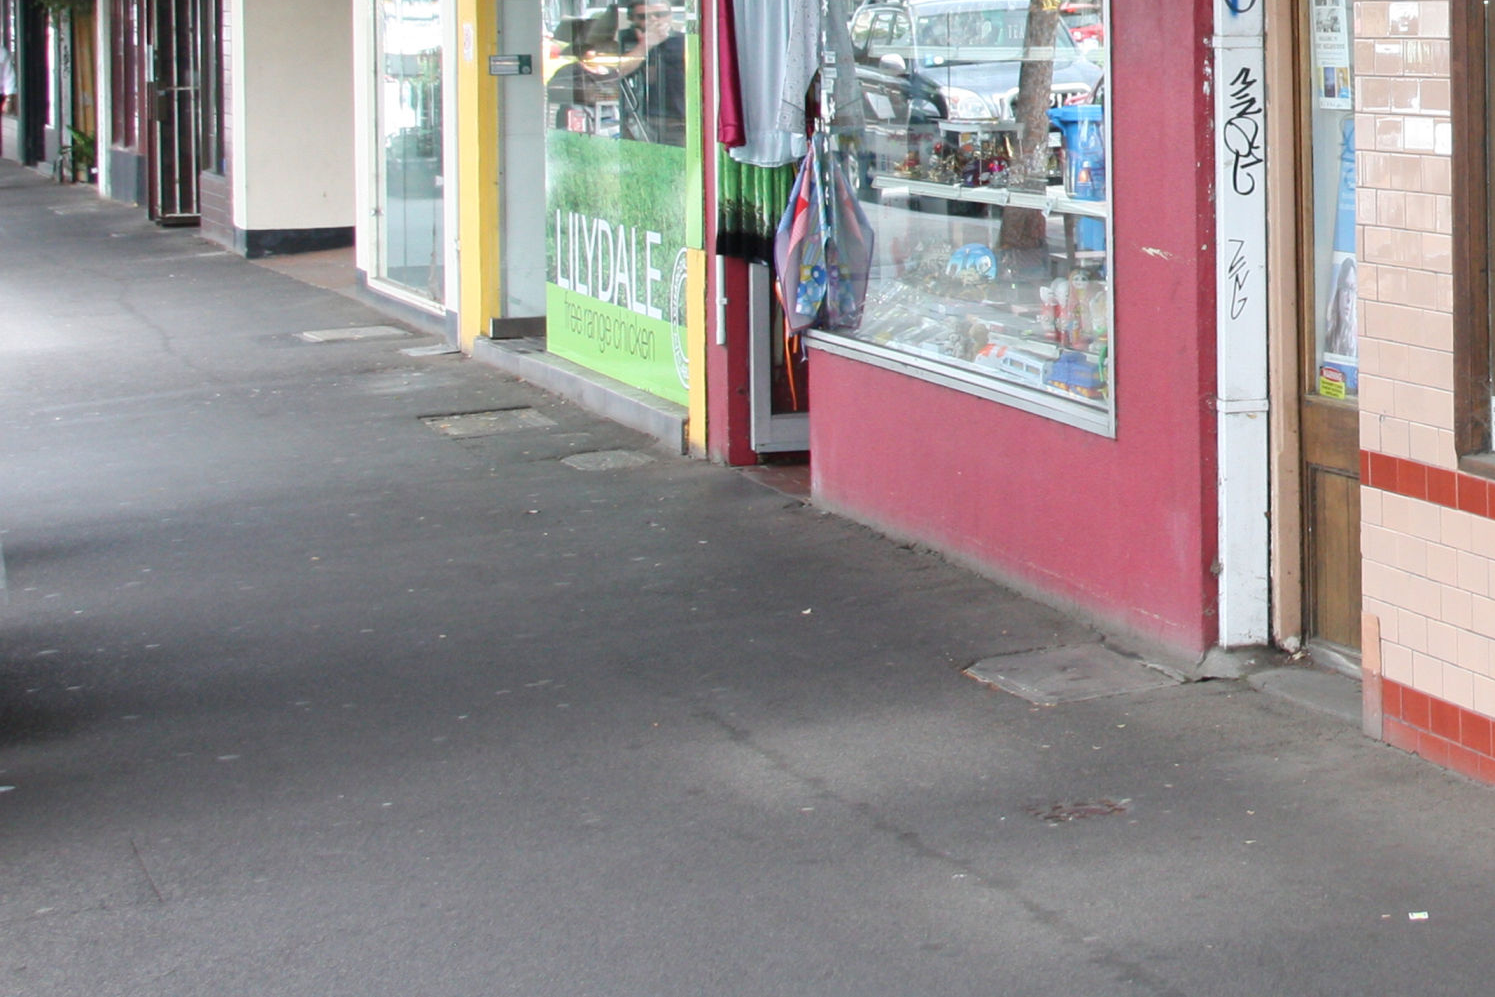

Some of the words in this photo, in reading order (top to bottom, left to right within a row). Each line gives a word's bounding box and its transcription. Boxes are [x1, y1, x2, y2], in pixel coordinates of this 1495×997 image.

[556, 209, 663, 320] LILYDALE
[564, 291, 583, 335] free
[583, 307, 612, 353] range
[615, 307, 656, 363] chicken
